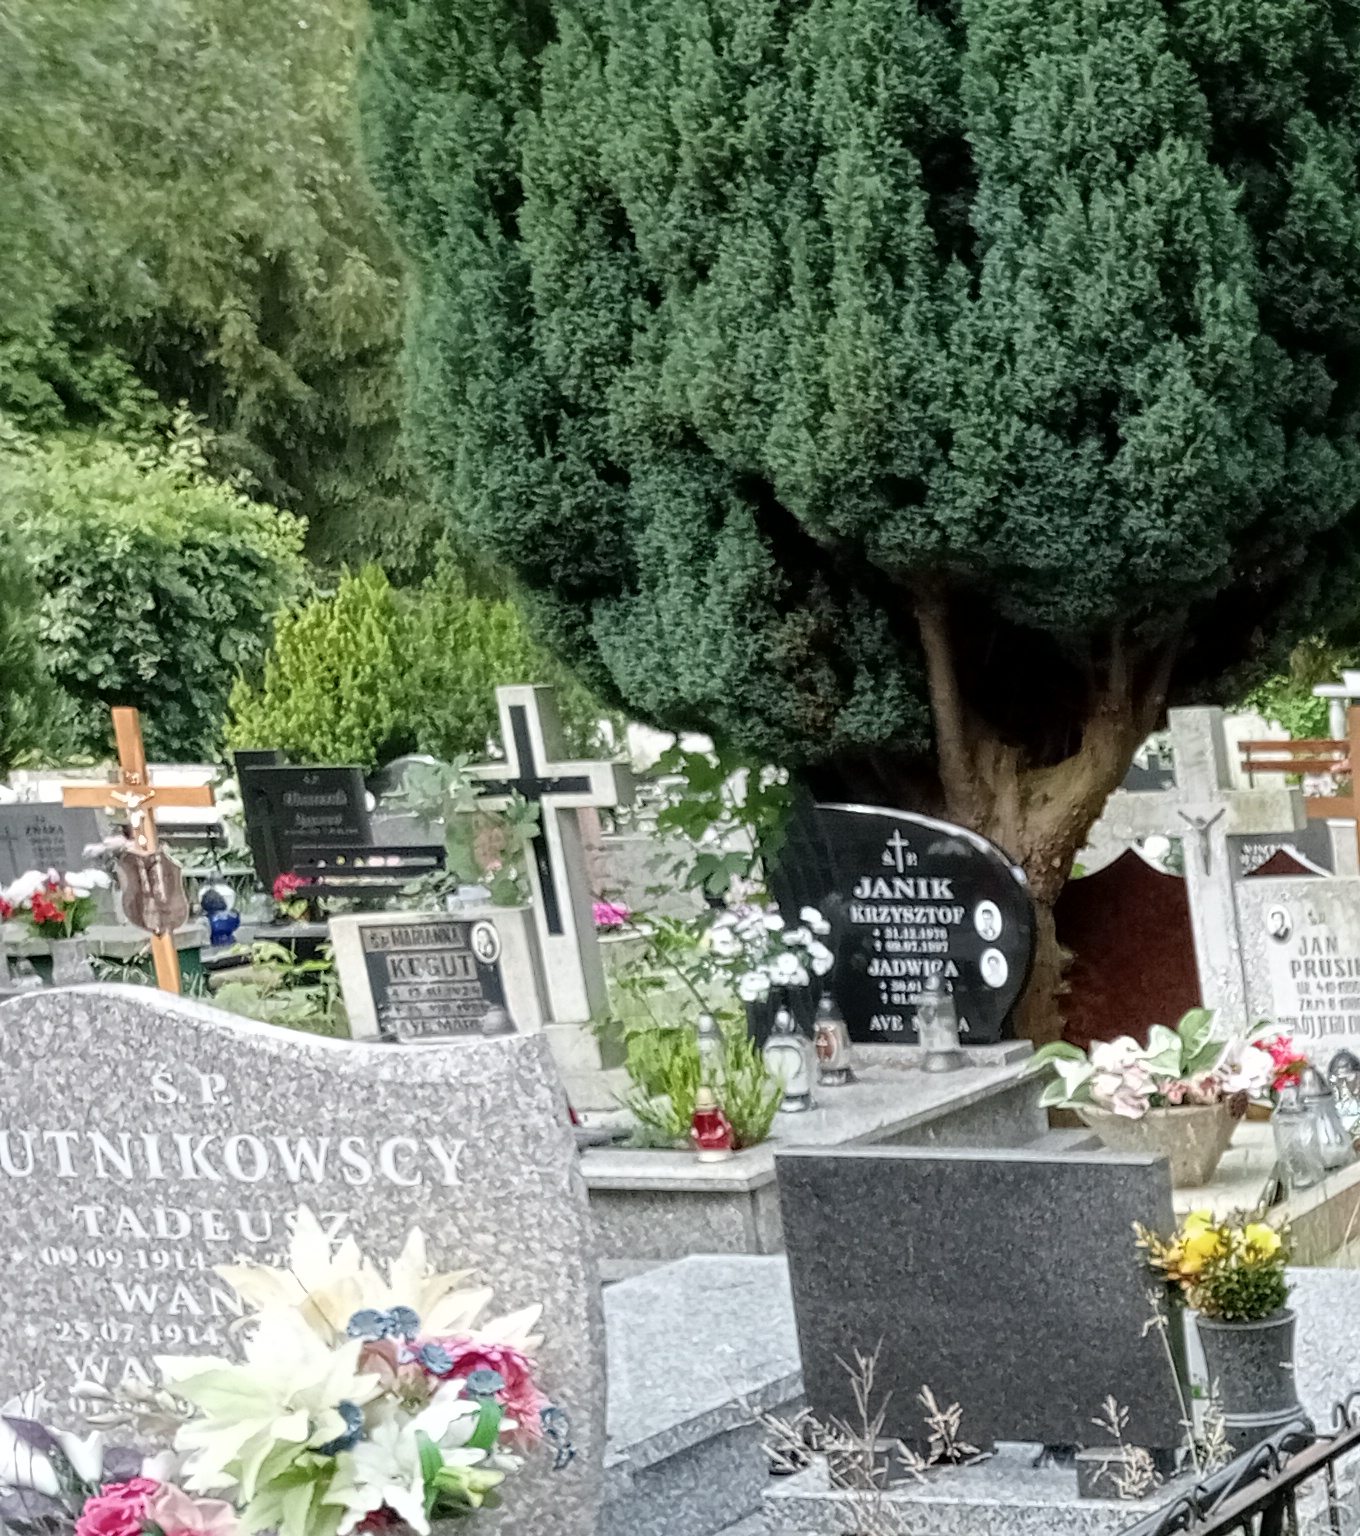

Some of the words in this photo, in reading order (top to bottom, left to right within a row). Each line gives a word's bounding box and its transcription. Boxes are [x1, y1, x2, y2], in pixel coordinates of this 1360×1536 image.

[853, 876, 955, 899] JANIK
[850, 905, 965, 924] KRZYSZTOF
[1299, 936, 1338, 956] JAN
[870, 1014, 903, 1031] AVE
